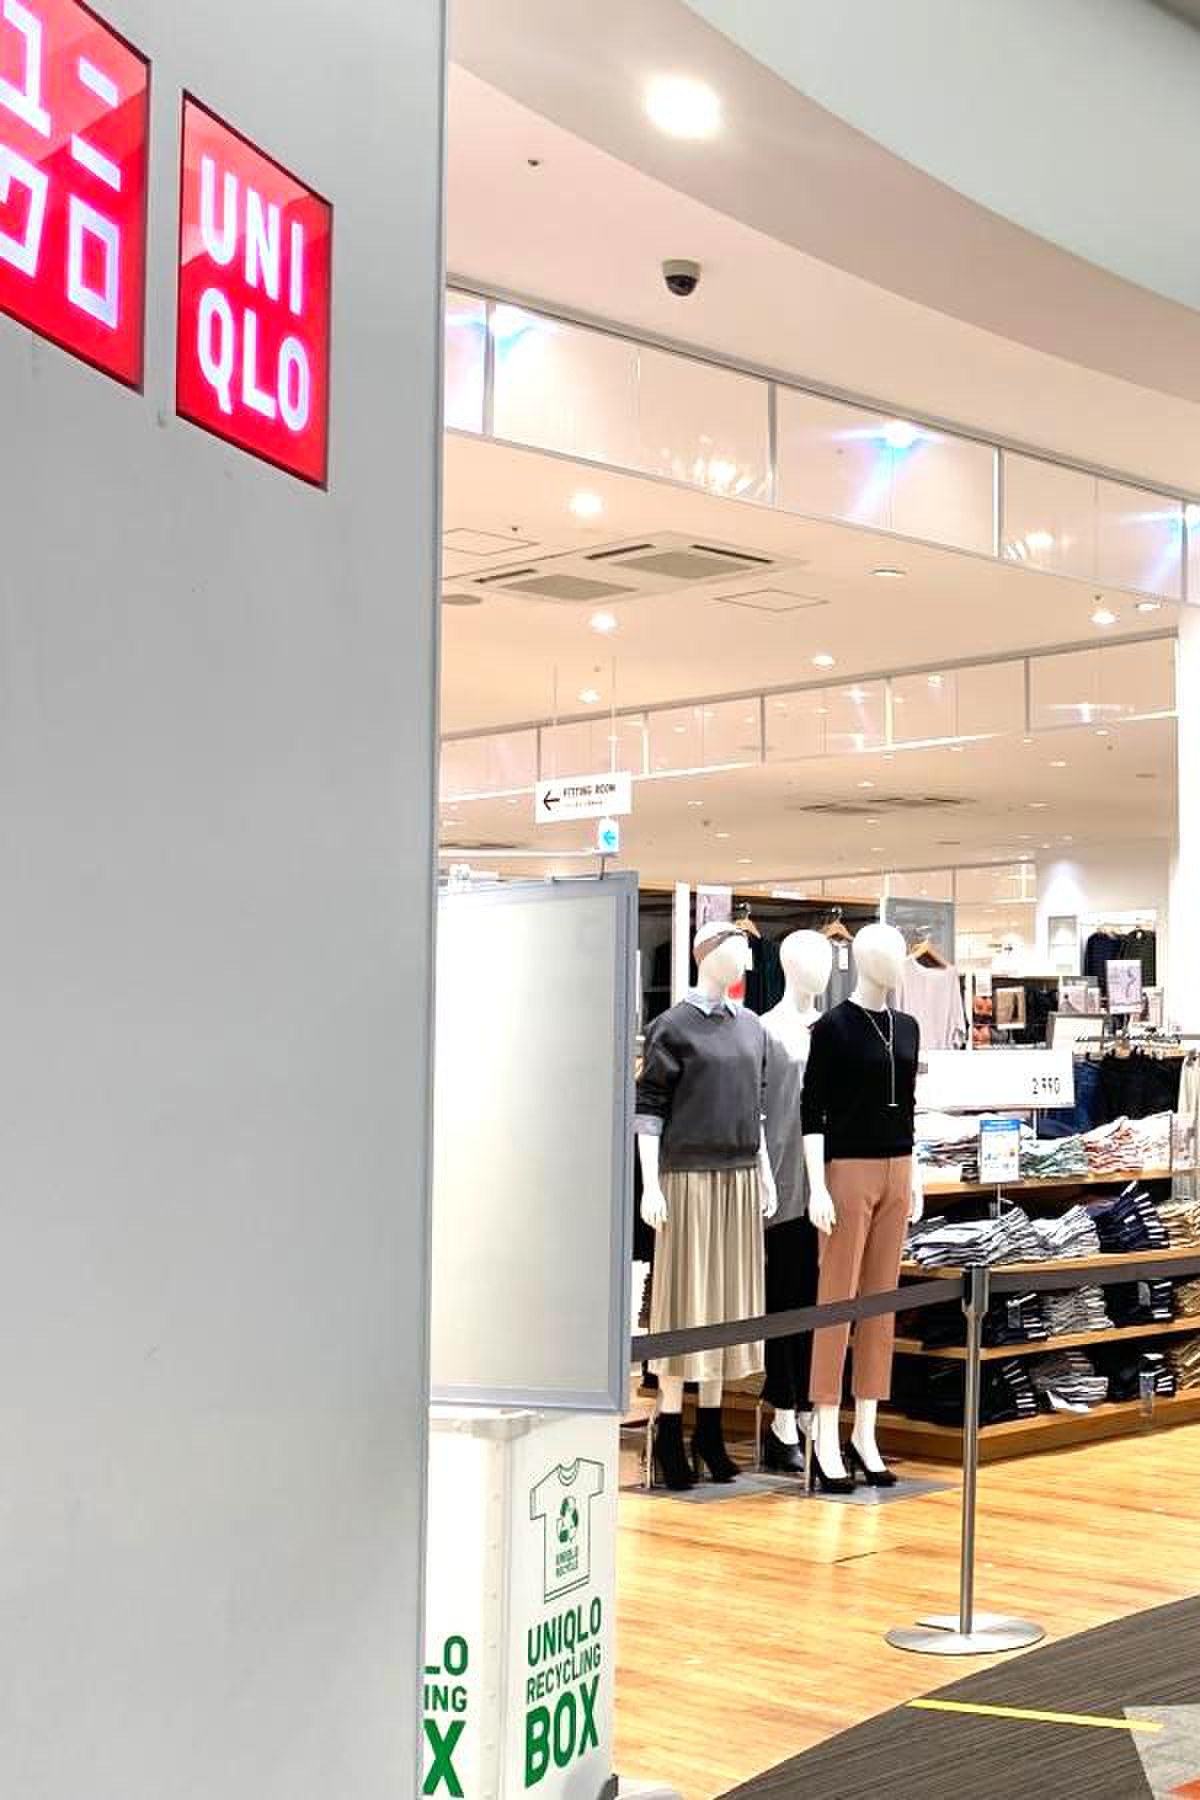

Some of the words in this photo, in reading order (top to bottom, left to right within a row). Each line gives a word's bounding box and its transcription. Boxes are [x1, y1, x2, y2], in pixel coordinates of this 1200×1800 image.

[201, 156, 304, 316] UNI
[197, 287, 310, 431] QLO
[526, 1643, 601, 1705] RECYCLING
[527, 1597, 601, 1666] UNIQLO
[525, 1674, 599, 1788] BOX
